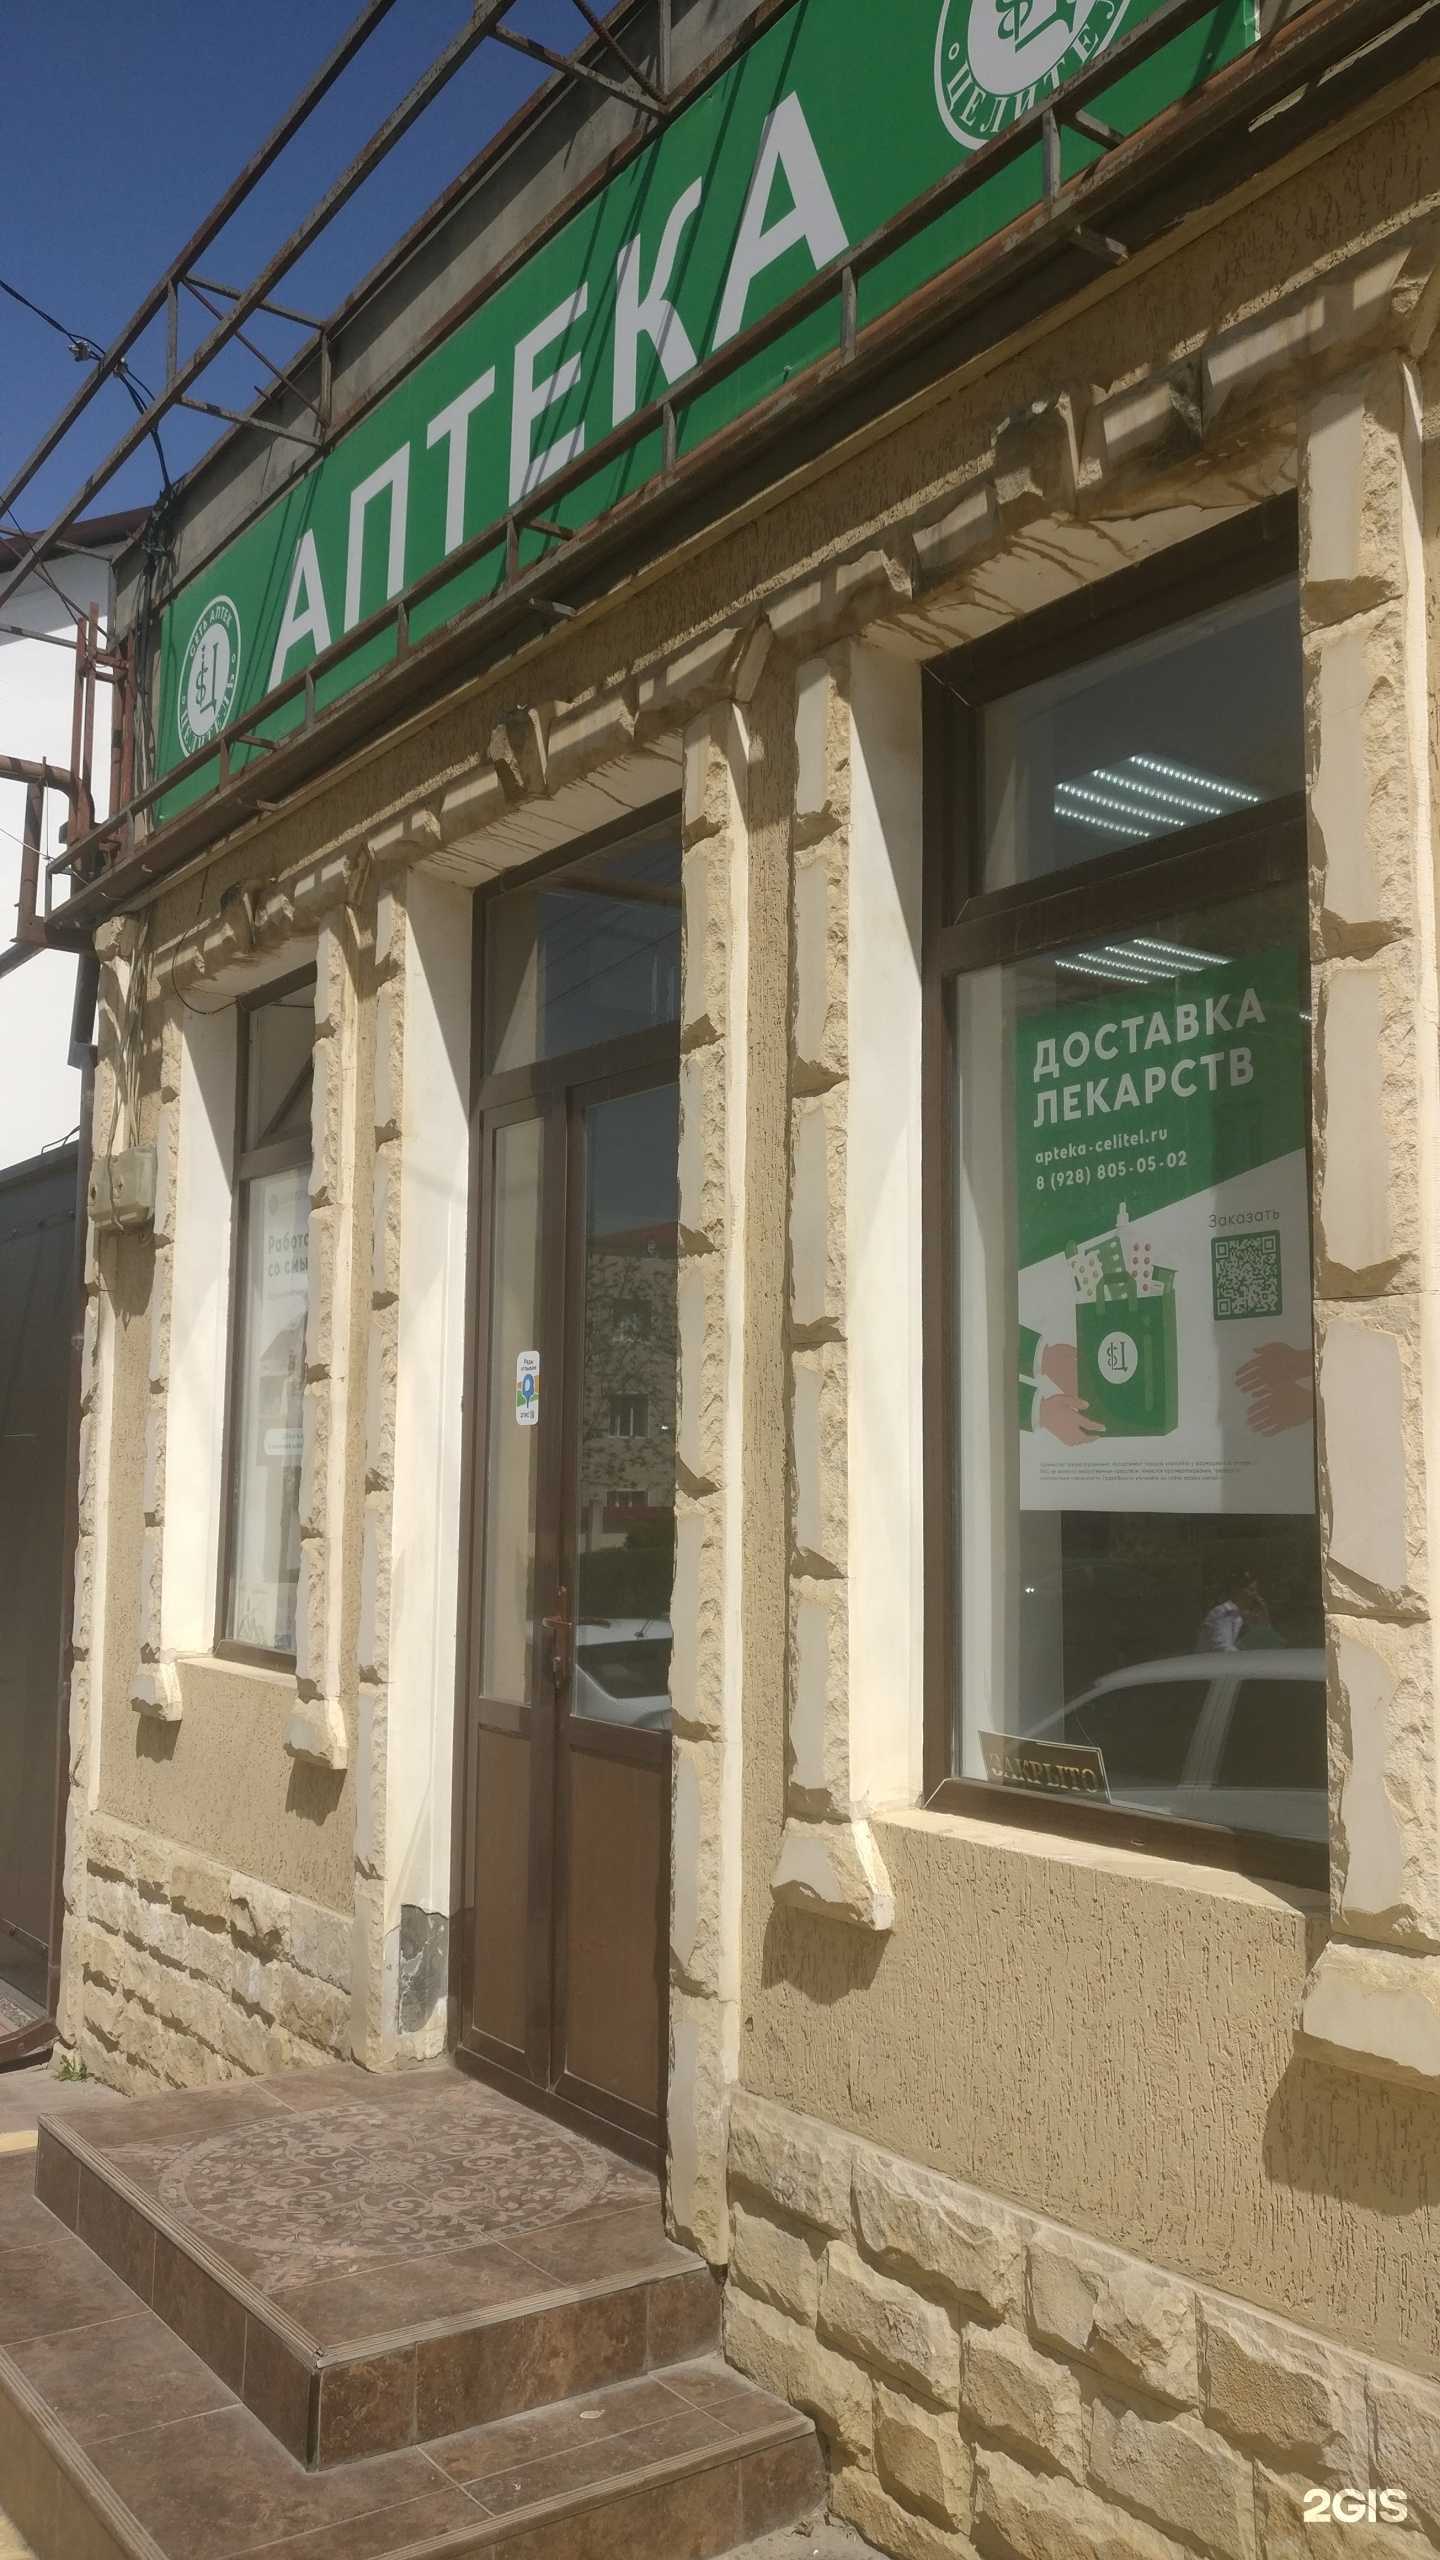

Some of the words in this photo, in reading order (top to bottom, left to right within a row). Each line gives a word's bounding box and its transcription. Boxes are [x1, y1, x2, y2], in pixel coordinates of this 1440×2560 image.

[267, 90, 850, 694] АПТЕКА
[1033, 987, 1267, 1083] ДОСТАВКА
[1033, 1046, 1255, 1128] ЛЕКАРСТВ
[1035, 1128, 1168, 1166] apteka-celitel.ru
[1036, 1175, 1045, 1191] 8
[1050, 1166, 1091, 1192] (928)
[1207, 1209, 1280, 1228] Заказать
